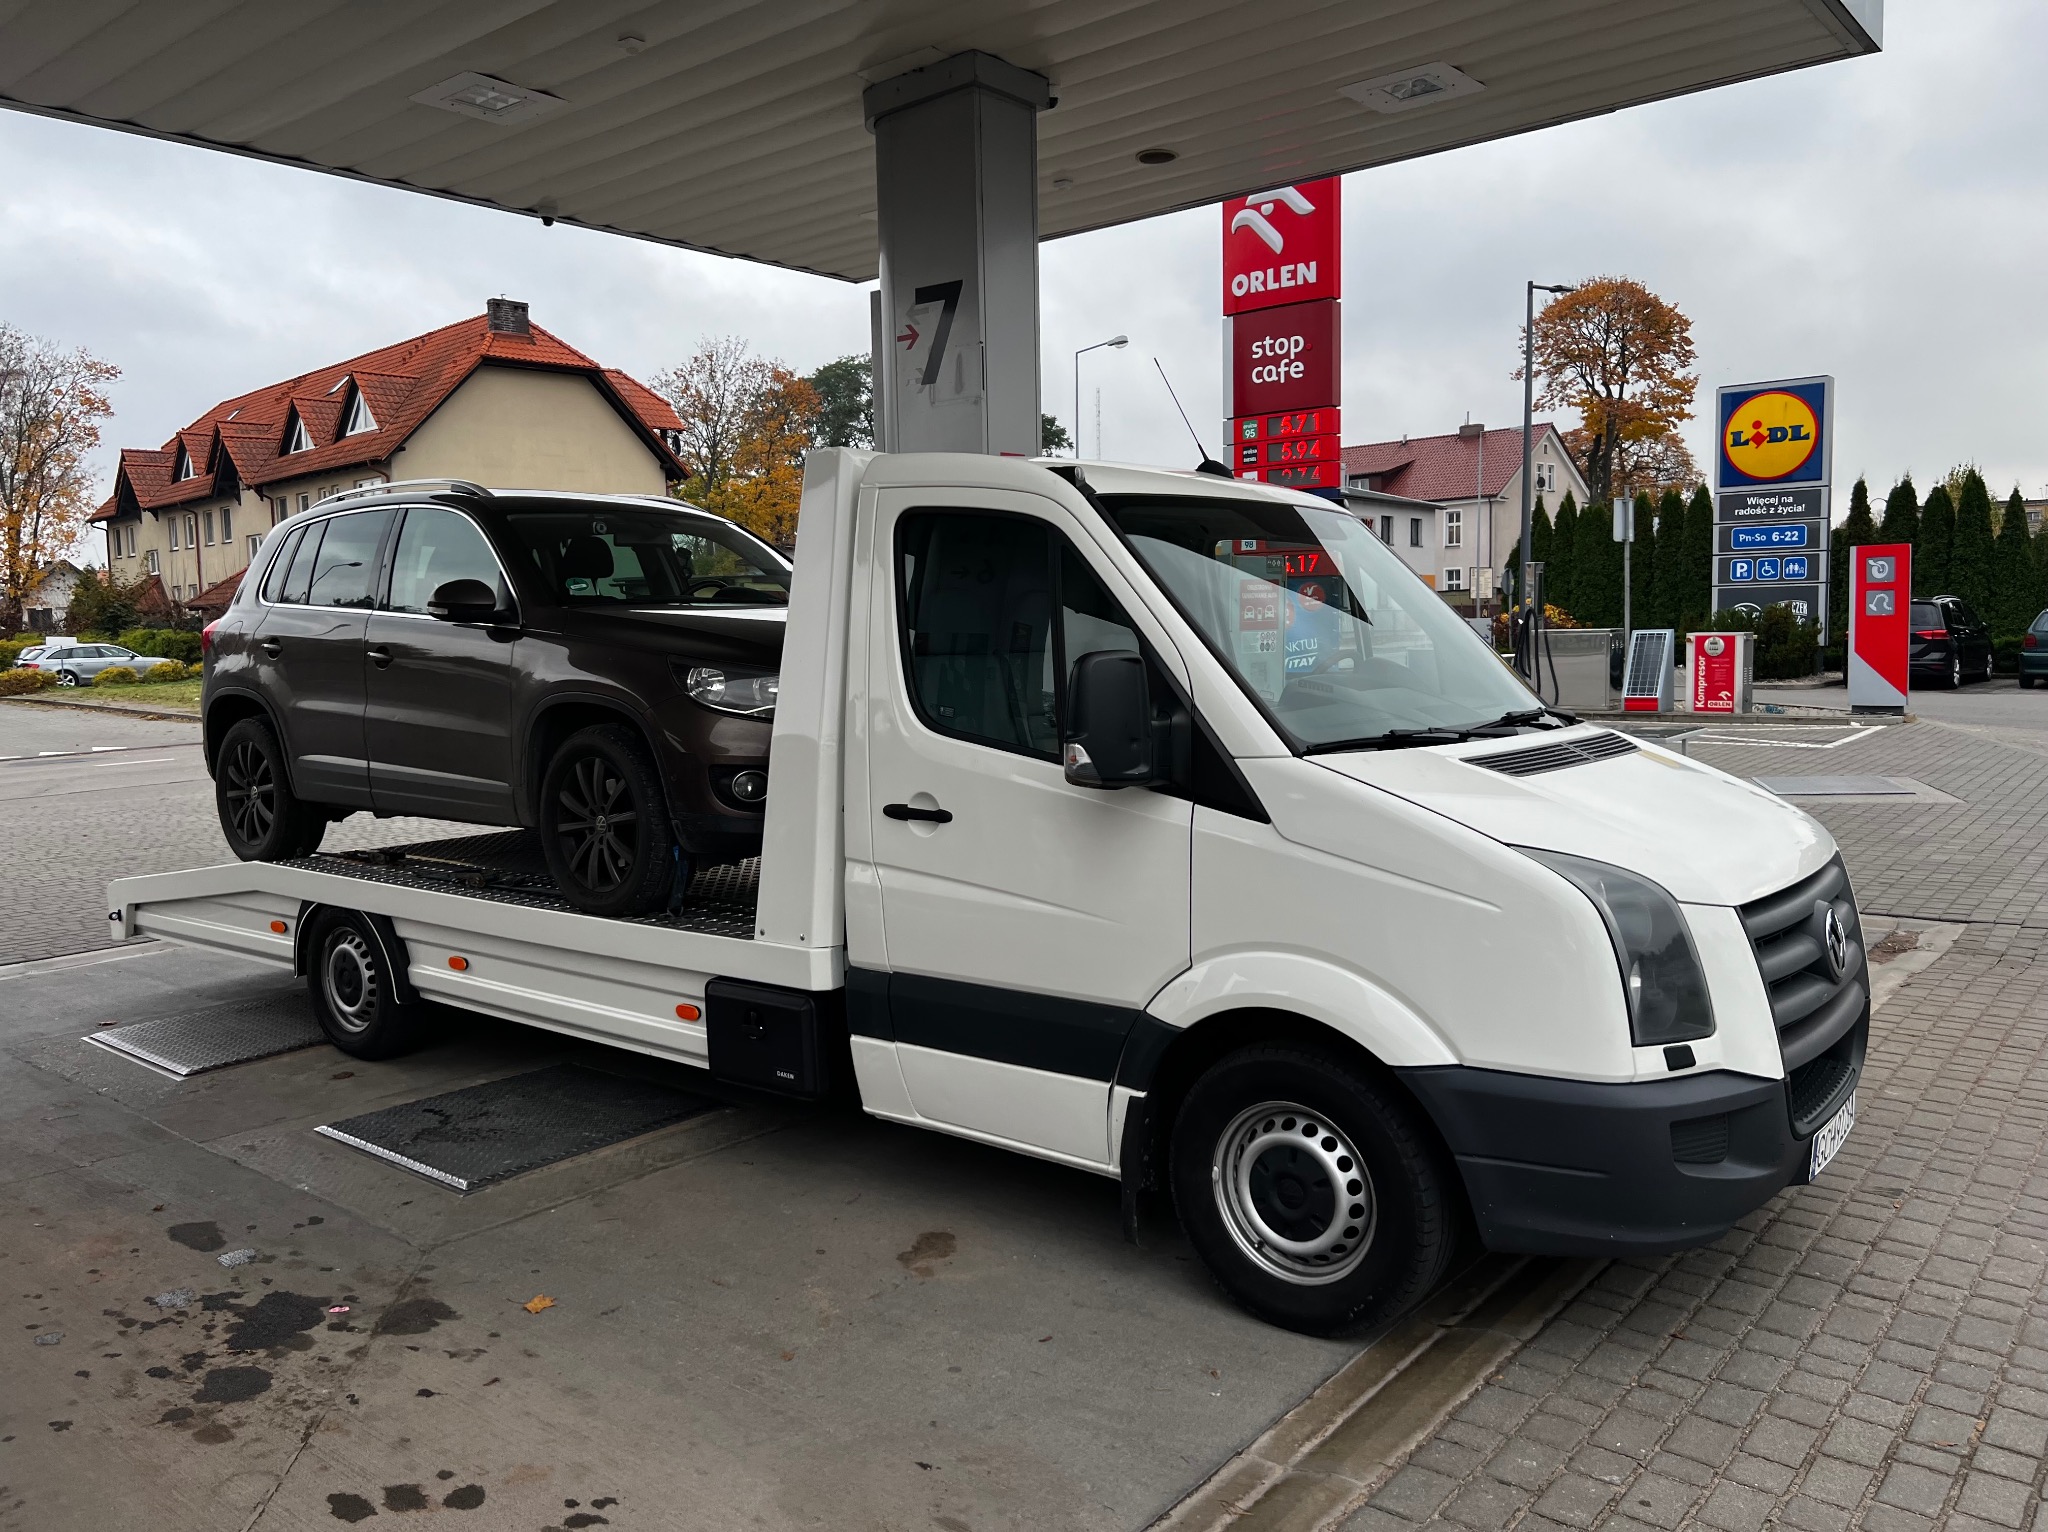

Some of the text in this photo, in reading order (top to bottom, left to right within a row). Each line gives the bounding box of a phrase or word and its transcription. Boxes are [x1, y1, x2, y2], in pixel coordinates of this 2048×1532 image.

[1232, 261, 1317, 297] ORLEN
[915, 280, 963, 385] 7
[1252, 359, 1304, 384] cafe
[1244, 428, 1256, 439] 95
[1280, 413, 1320, 434] 5.71
[1281, 439, 1321, 461] 5.94
[1734, 505, 1767, 516] radość
[1777, 504, 1805, 515] życia!
[1747, 495, 1793, 507] Więcej na
[1739, 531, 1799, 542] Pn-So 6-22
[1736, 562, 1748, 578] P
[1695, 655, 1708, 708] Kompresor
